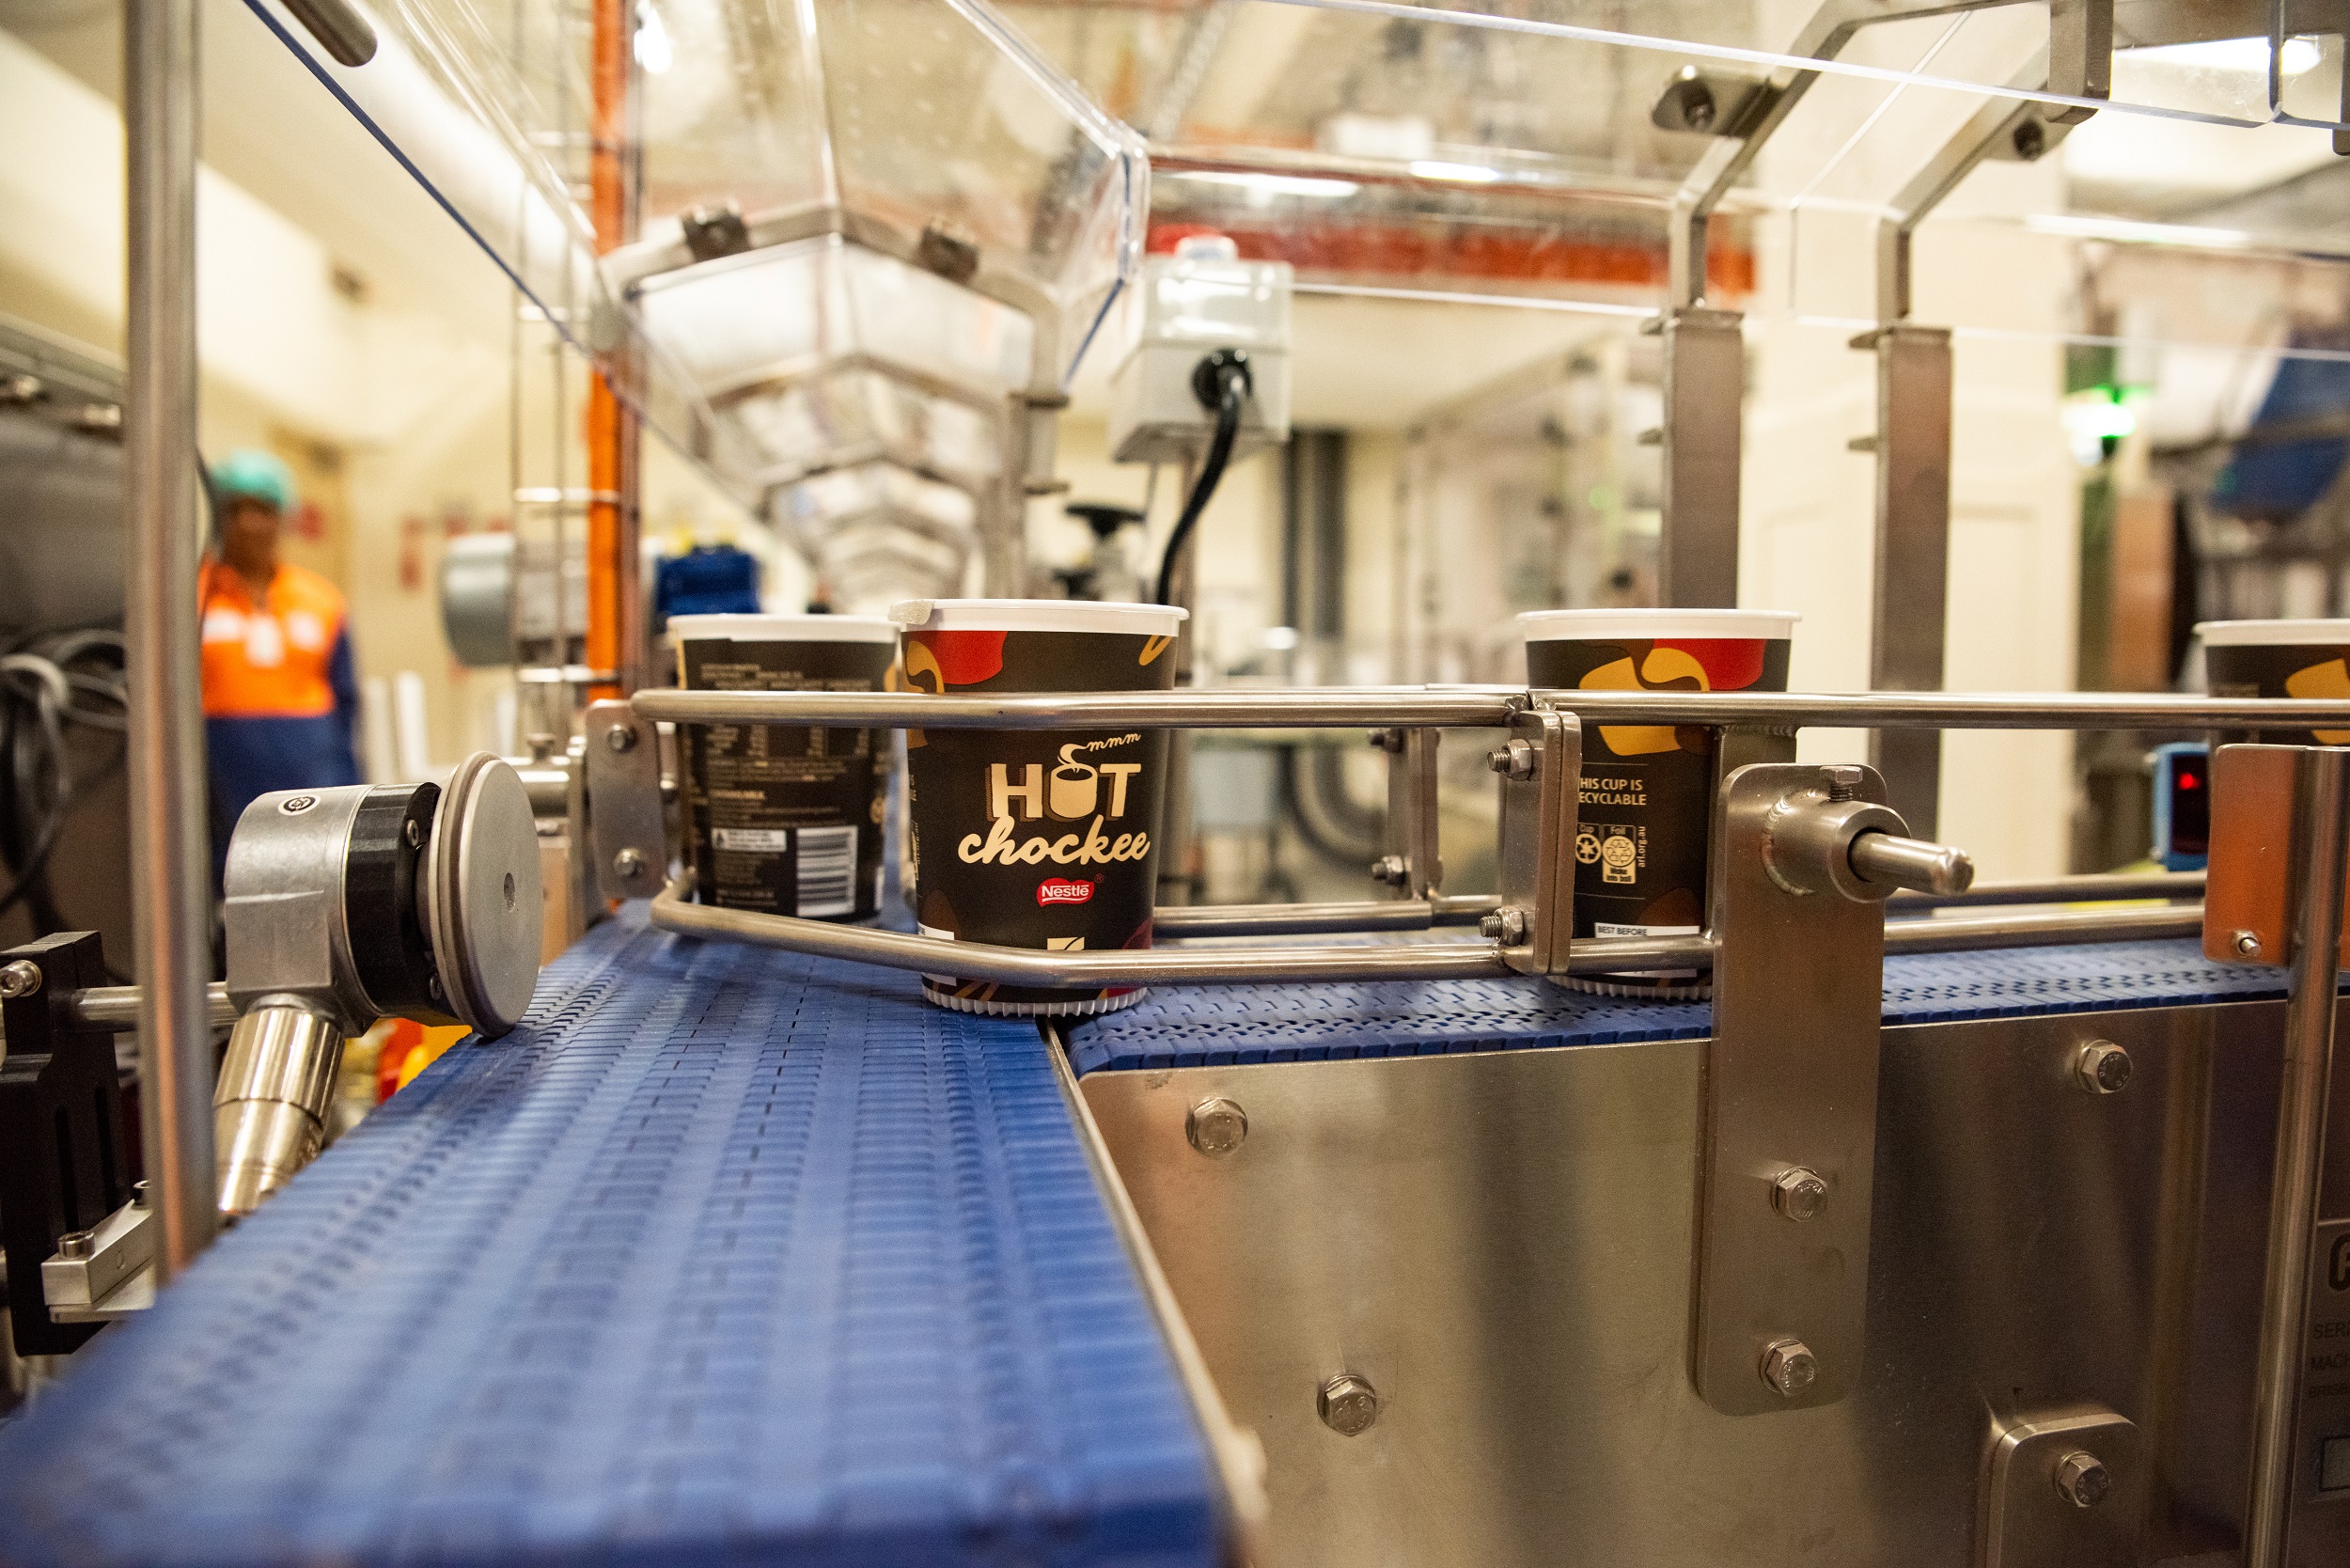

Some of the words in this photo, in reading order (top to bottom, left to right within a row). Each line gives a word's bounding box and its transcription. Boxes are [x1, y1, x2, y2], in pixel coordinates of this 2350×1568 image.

[1087, 732, 1141, 752] mmm
[1579, 777, 1599, 790] HIS
[1601, 778, 1628, 791] CUP
[1630, 779, 1643, 791] IS
[986, 762, 1142, 821] HOT
[1579, 792, 1647, 806] ECYCLABLE
[958, 814, 1152, 866] chockee
[1042, 885, 1089, 898] Nestlé
[1598, 925, 1615, 934] BEST
[1617, 927, 1647, 936] BEFORE
